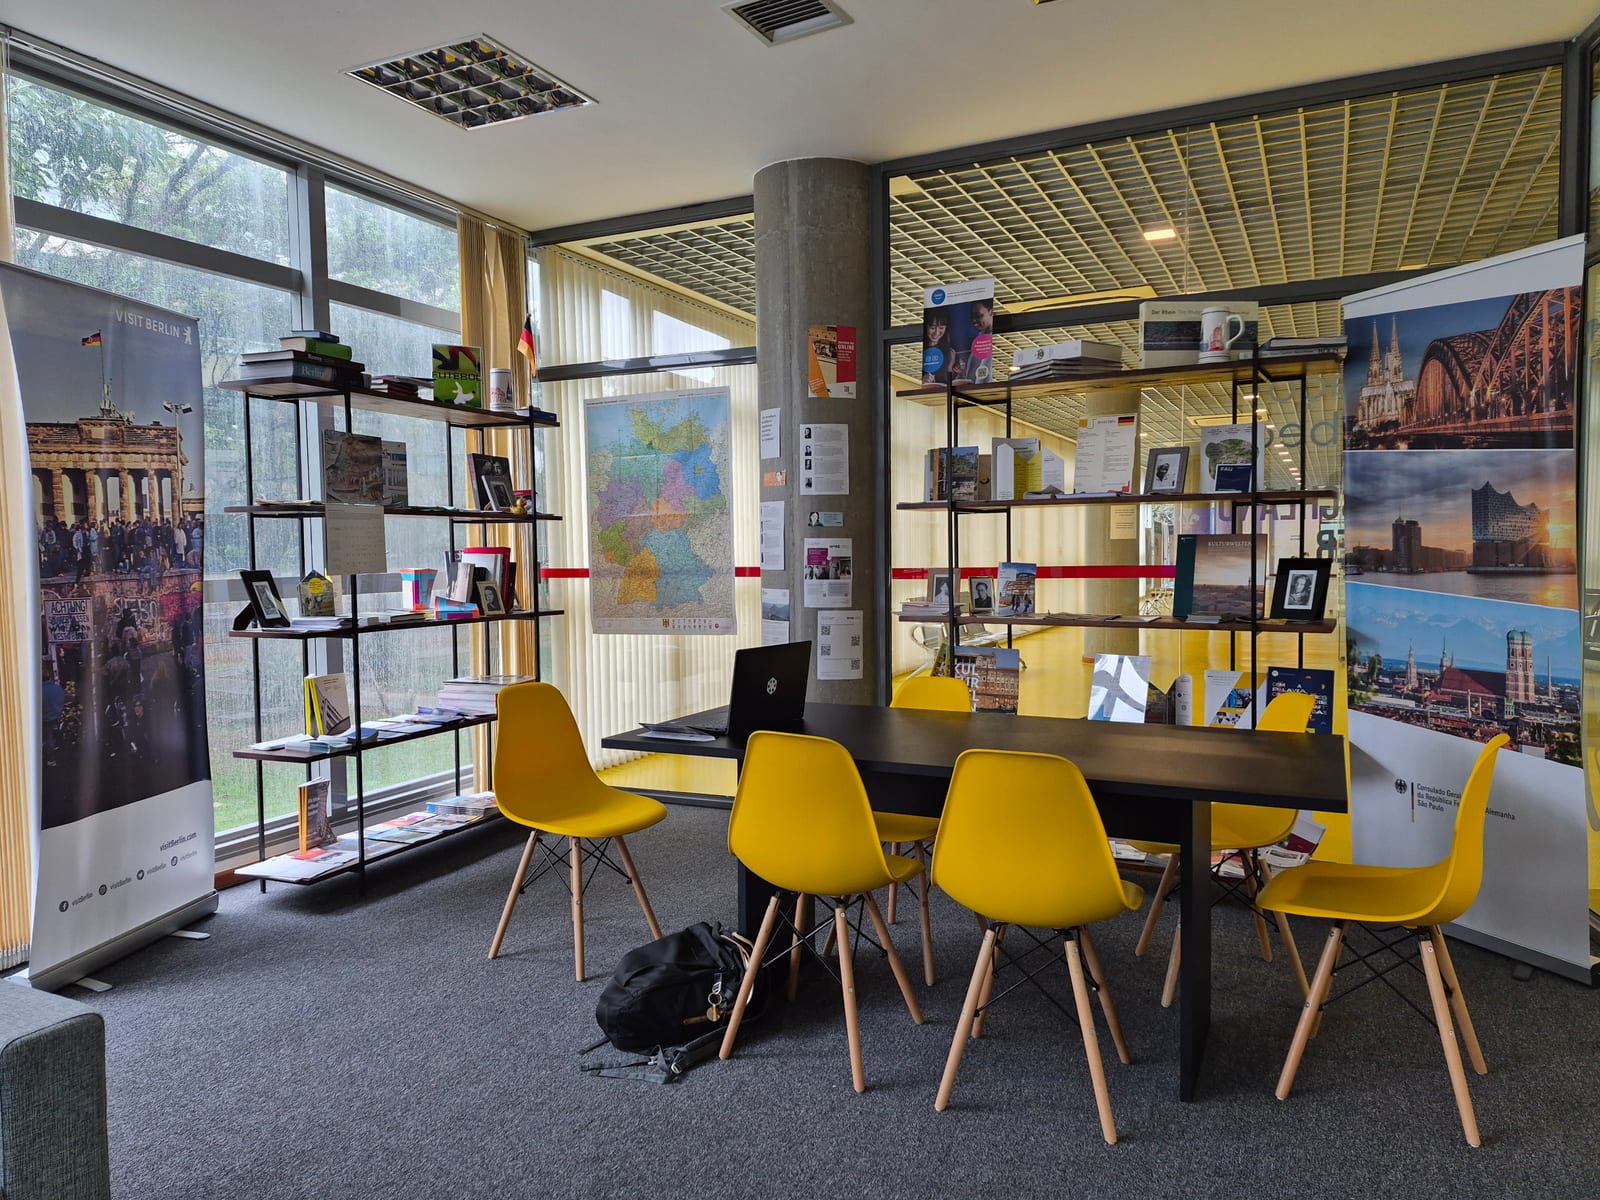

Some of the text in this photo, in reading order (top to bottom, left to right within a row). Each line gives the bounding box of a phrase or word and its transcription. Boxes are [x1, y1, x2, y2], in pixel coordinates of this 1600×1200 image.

[116, 309, 180, 338] VISIT BERLIN
[432, 371, 482, 381] FUTEBOL
[1417, 783, 1461, 799] Consulado Geral
[1417, 799, 1444, 812] São Paulo
[1426, 793, 1452, 807] República
[1485, 807, 1516, 820] Alemanha
[159, 831, 197, 851] visitBerlin.com
